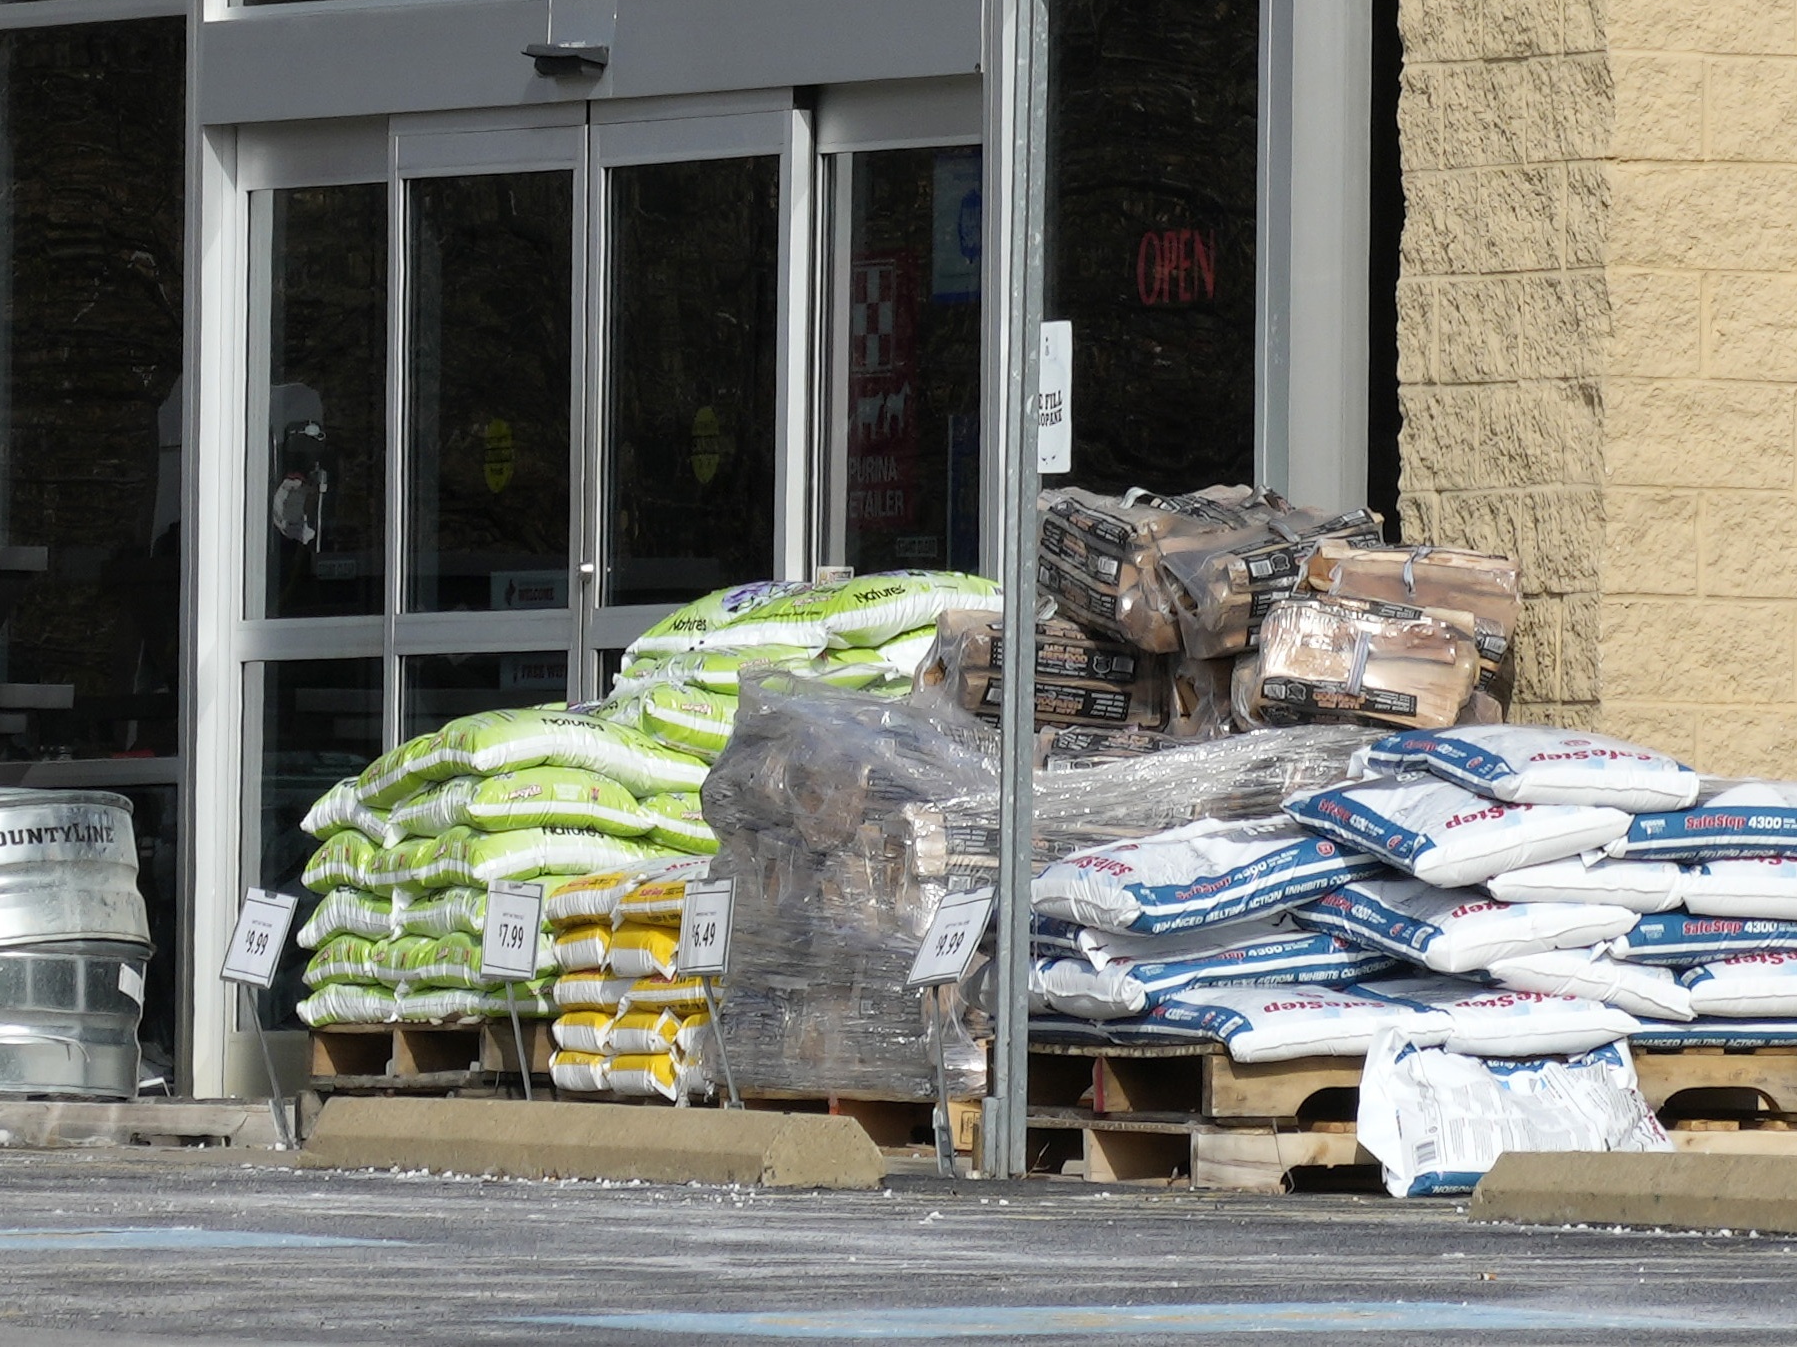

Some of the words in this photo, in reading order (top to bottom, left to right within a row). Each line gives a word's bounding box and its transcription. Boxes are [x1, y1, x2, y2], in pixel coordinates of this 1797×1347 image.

[1136, 228, 1216, 306] OPEN
[1045, 390, 1062, 410] FILL
[848, 489, 904, 518] ETAILER
[1747, 815, 1782, 830] 4300
[1248, 891, 1283, 910] ACTION
[498, 923, 523, 950] $7.99
[1743, 919, 1778, 935] 4300
